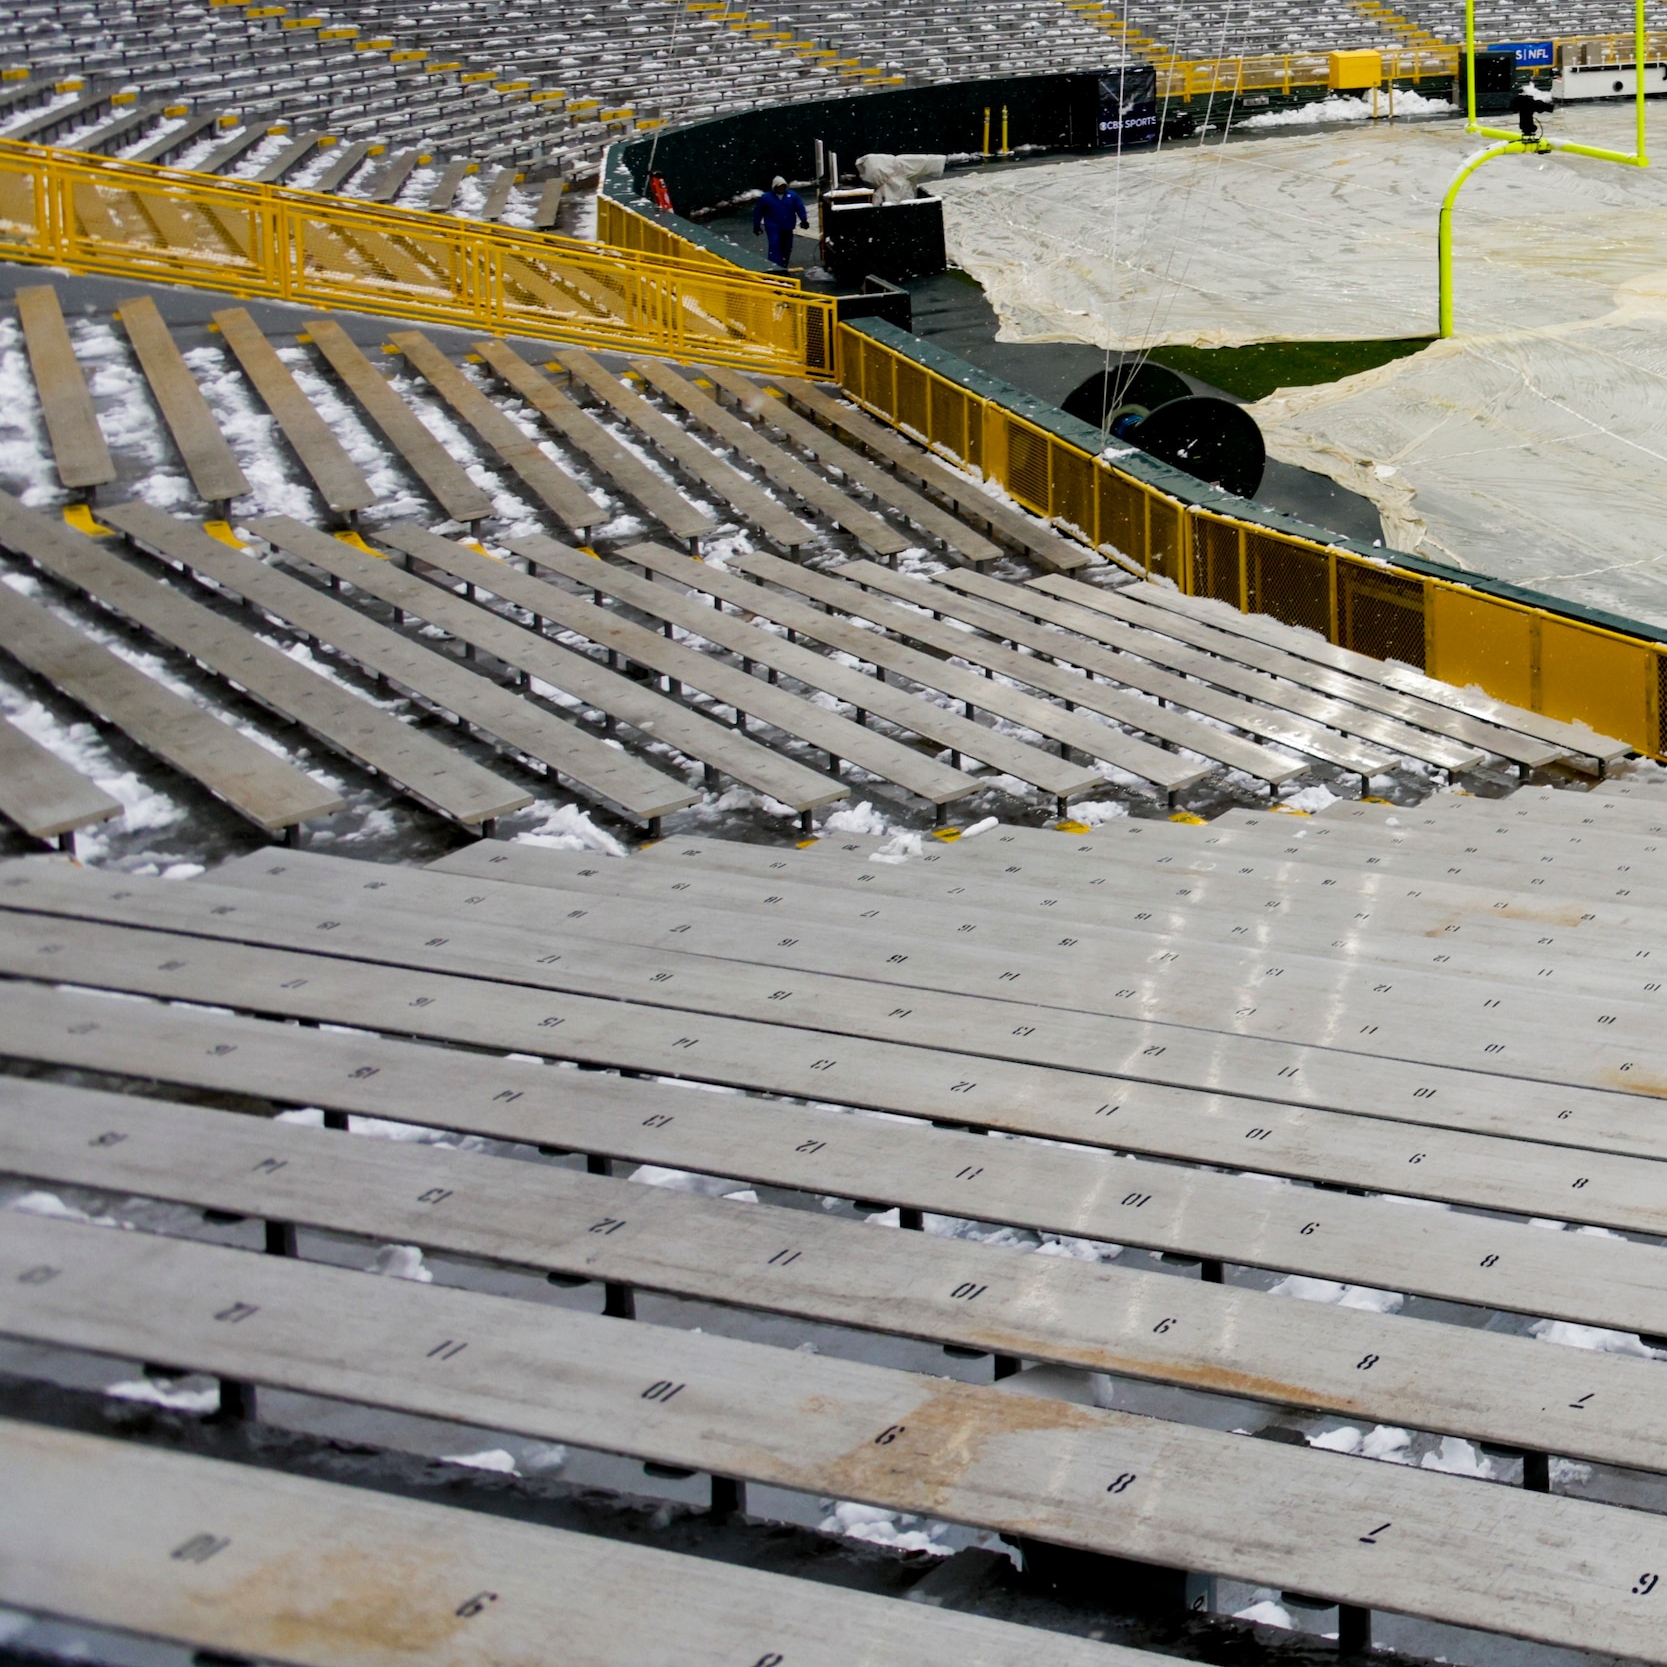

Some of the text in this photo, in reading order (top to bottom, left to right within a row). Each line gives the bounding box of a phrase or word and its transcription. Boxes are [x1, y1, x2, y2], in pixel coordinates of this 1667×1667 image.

[1528, 48, 1549, 60] NFL
[1107, 116, 1156, 130] CBS SPORTS
